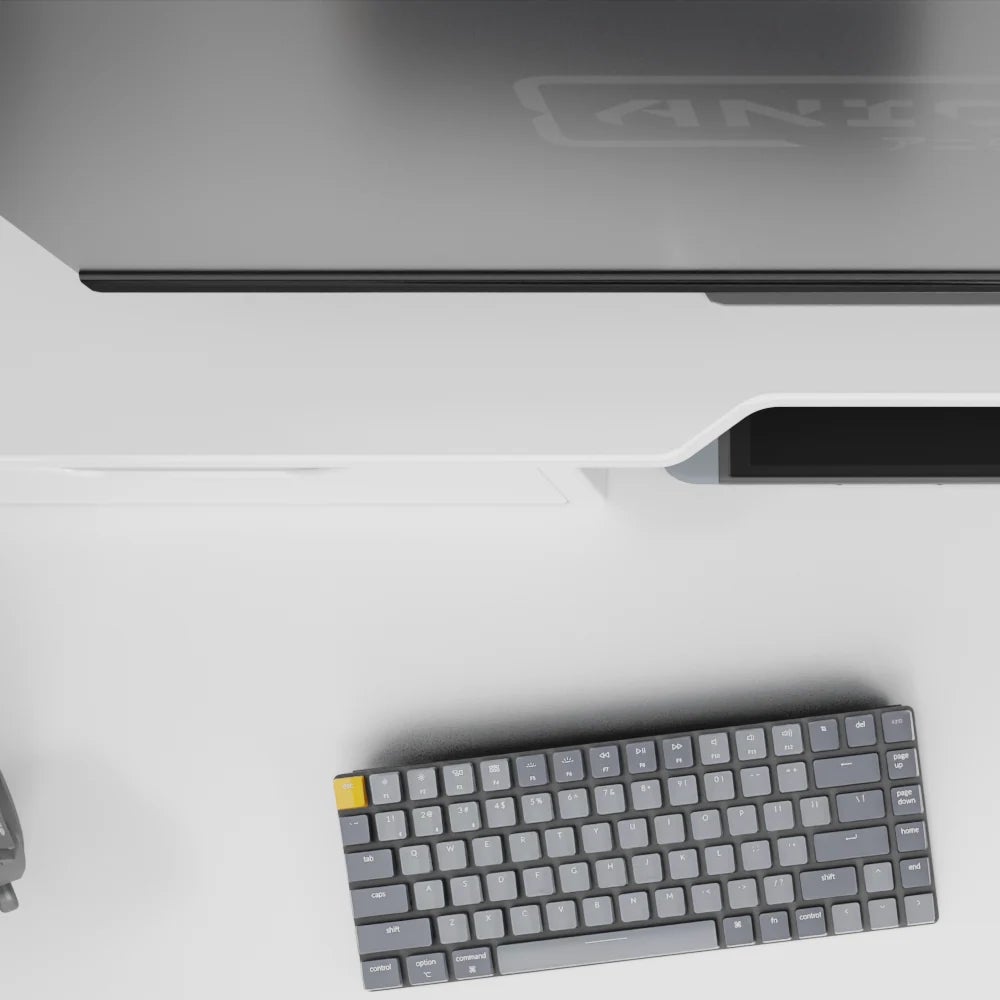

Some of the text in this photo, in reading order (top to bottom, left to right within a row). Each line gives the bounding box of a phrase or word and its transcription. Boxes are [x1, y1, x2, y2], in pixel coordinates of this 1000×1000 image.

[855, 720, 865, 728] del
[893, 752, 909, 760] page
[894, 762, 903, 770] up
[896, 789, 912, 797] page
[897, 797, 916, 805] down
[901, 827, 919, 835] home
[363, 855, 374, 863] tab
[821, 873, 836, 881] shift
[370, 891, 386, 899] caps
[799, 912, 822, 921] control
[386, 926, 401, 934] shift
[455, 952, 487, 962] command
[415, 959, 437, 968] option
[369, 964, 392, 973] control
